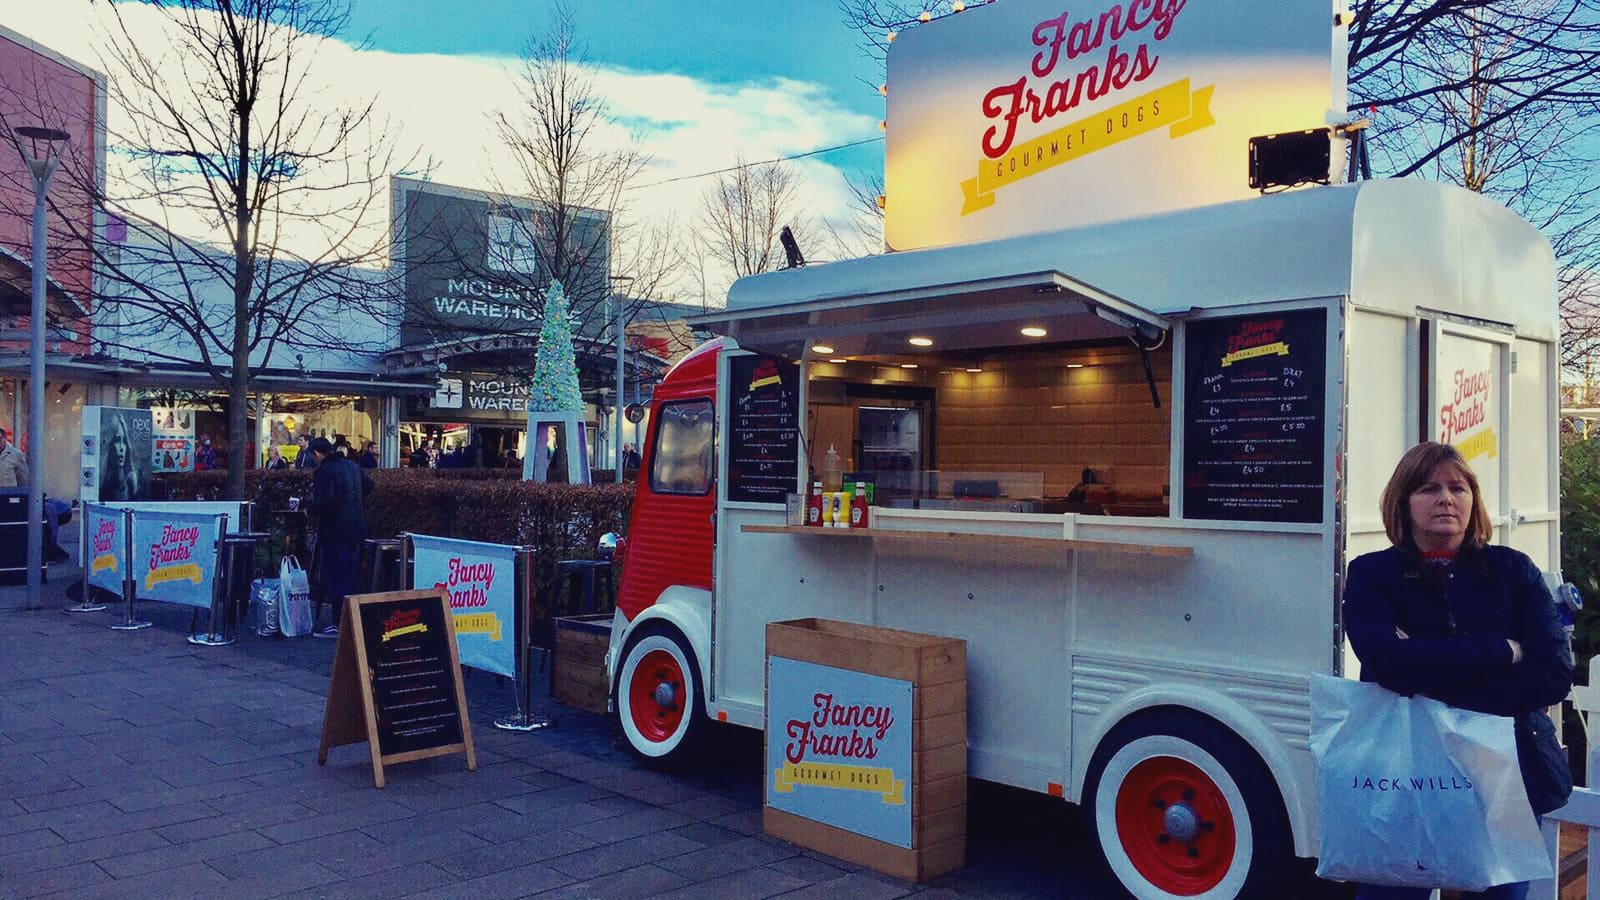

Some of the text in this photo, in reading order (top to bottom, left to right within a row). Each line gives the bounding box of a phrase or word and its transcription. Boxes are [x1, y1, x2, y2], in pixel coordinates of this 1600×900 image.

[1032, 0, 1188, 77] Fancy
[982, 43, 1159, 158] Franks
[996, 99, 1161, 177] GOURMET DOGS
[434, 296, 583, 325] WAREHOE
[1454, 368, 1492, 406] Fancy
[1441, 398, 1486, 444] Franks
[161, 523, 200, 547] Fancy
[149, 542, 191, 571] Franks
[448, 557, 495, 591] Fancy
[812, 692, 895, 741] Fancy
[785, 719, 879, 765] Franks
[793, 767, 880, 785] GOURMET DOGS
[1352, 776, 1401, 791] JACK
